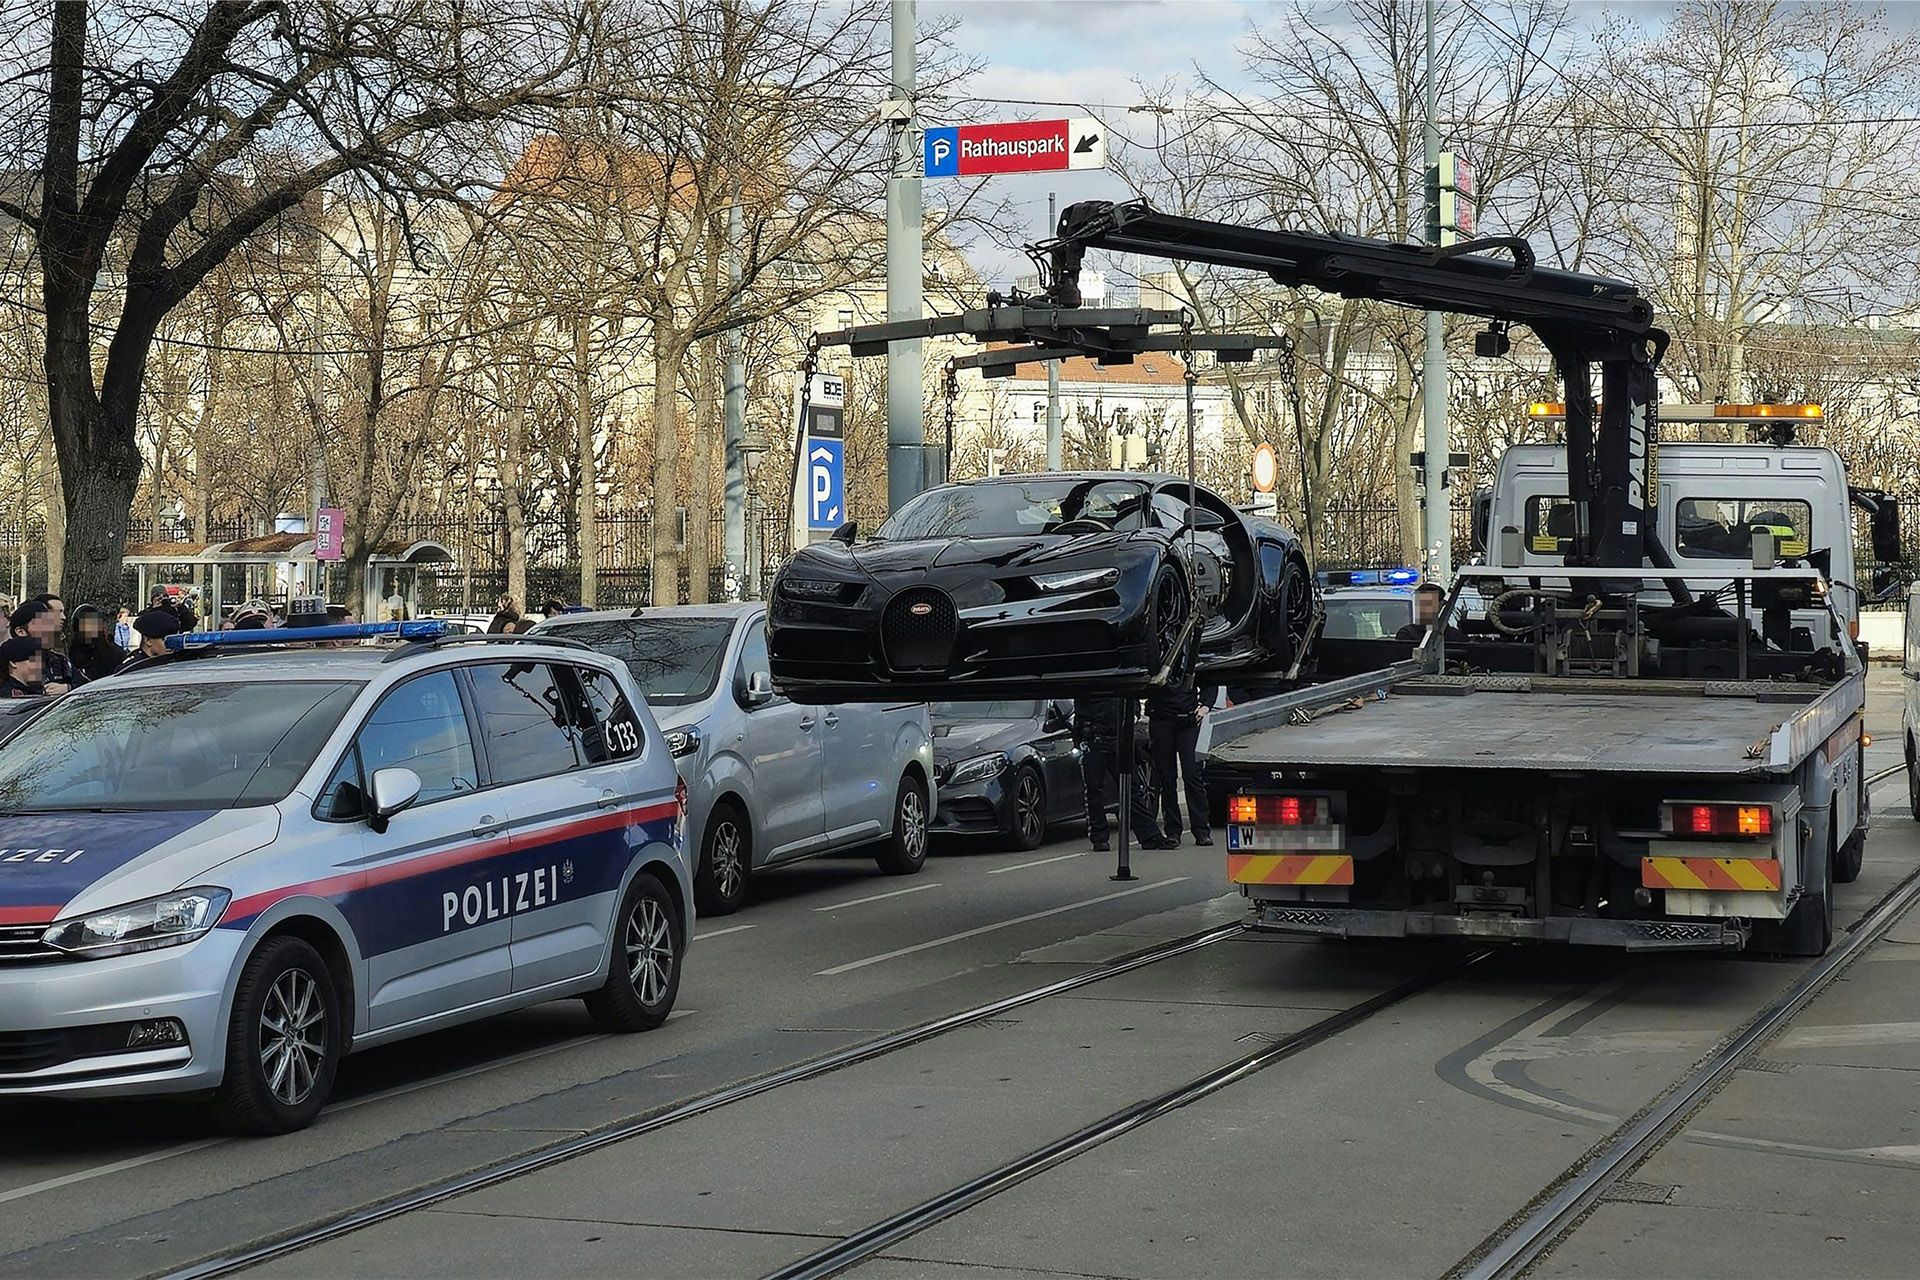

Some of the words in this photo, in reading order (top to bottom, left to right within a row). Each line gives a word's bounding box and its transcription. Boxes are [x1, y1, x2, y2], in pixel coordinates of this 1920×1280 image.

[961, 134, 1066, 158] Rathauspark
[1628, 397, 1647, 511] PAUK
[1649, 445, 1657, 504] PALFINGER
[812, 465, 831, 521] P
[613, 721, 638, 752] 133
[1241, 828, 1254, 846] W
[442, 865, 557, 932] POLIZEI
